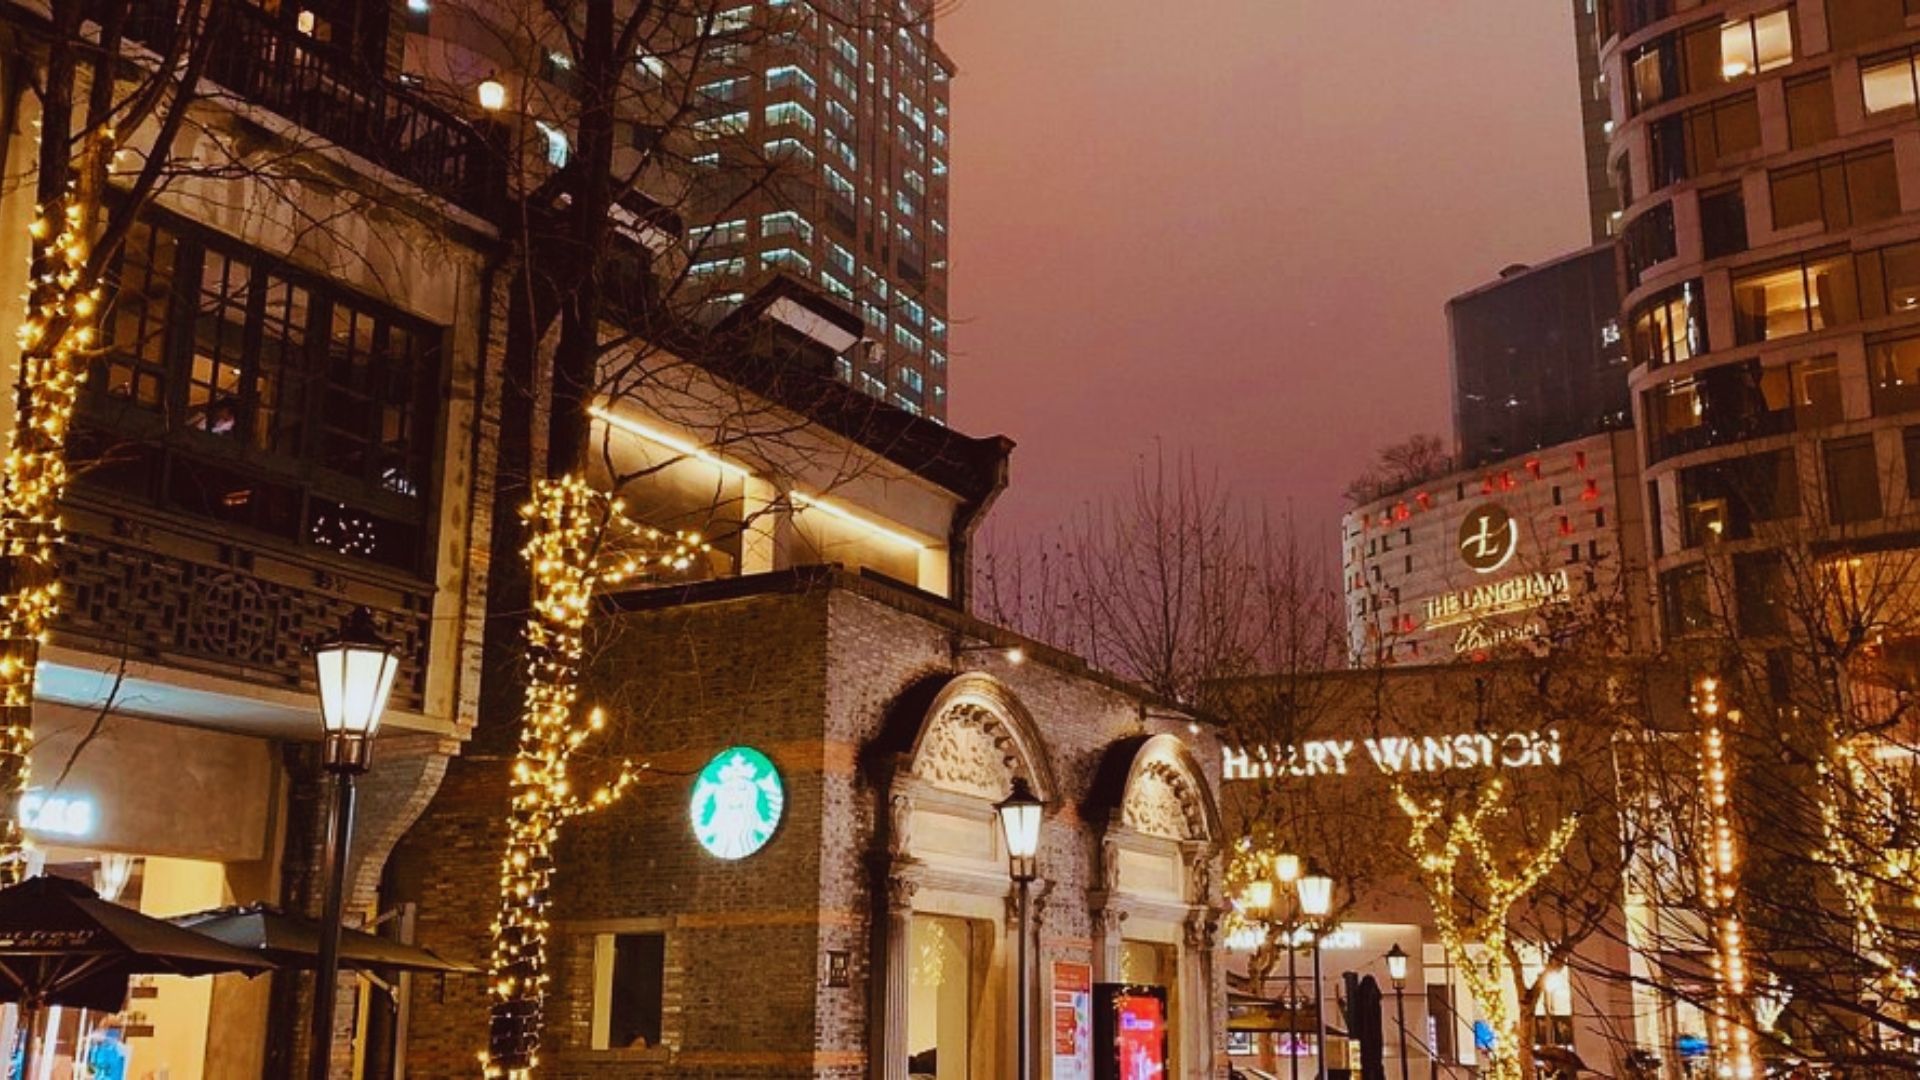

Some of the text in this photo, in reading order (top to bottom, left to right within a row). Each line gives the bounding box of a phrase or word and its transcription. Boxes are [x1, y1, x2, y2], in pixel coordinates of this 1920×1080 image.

[1425, 569, 1569, 619] THE LANGHAM
[1365, 729, 1561, 774] WINSTON
